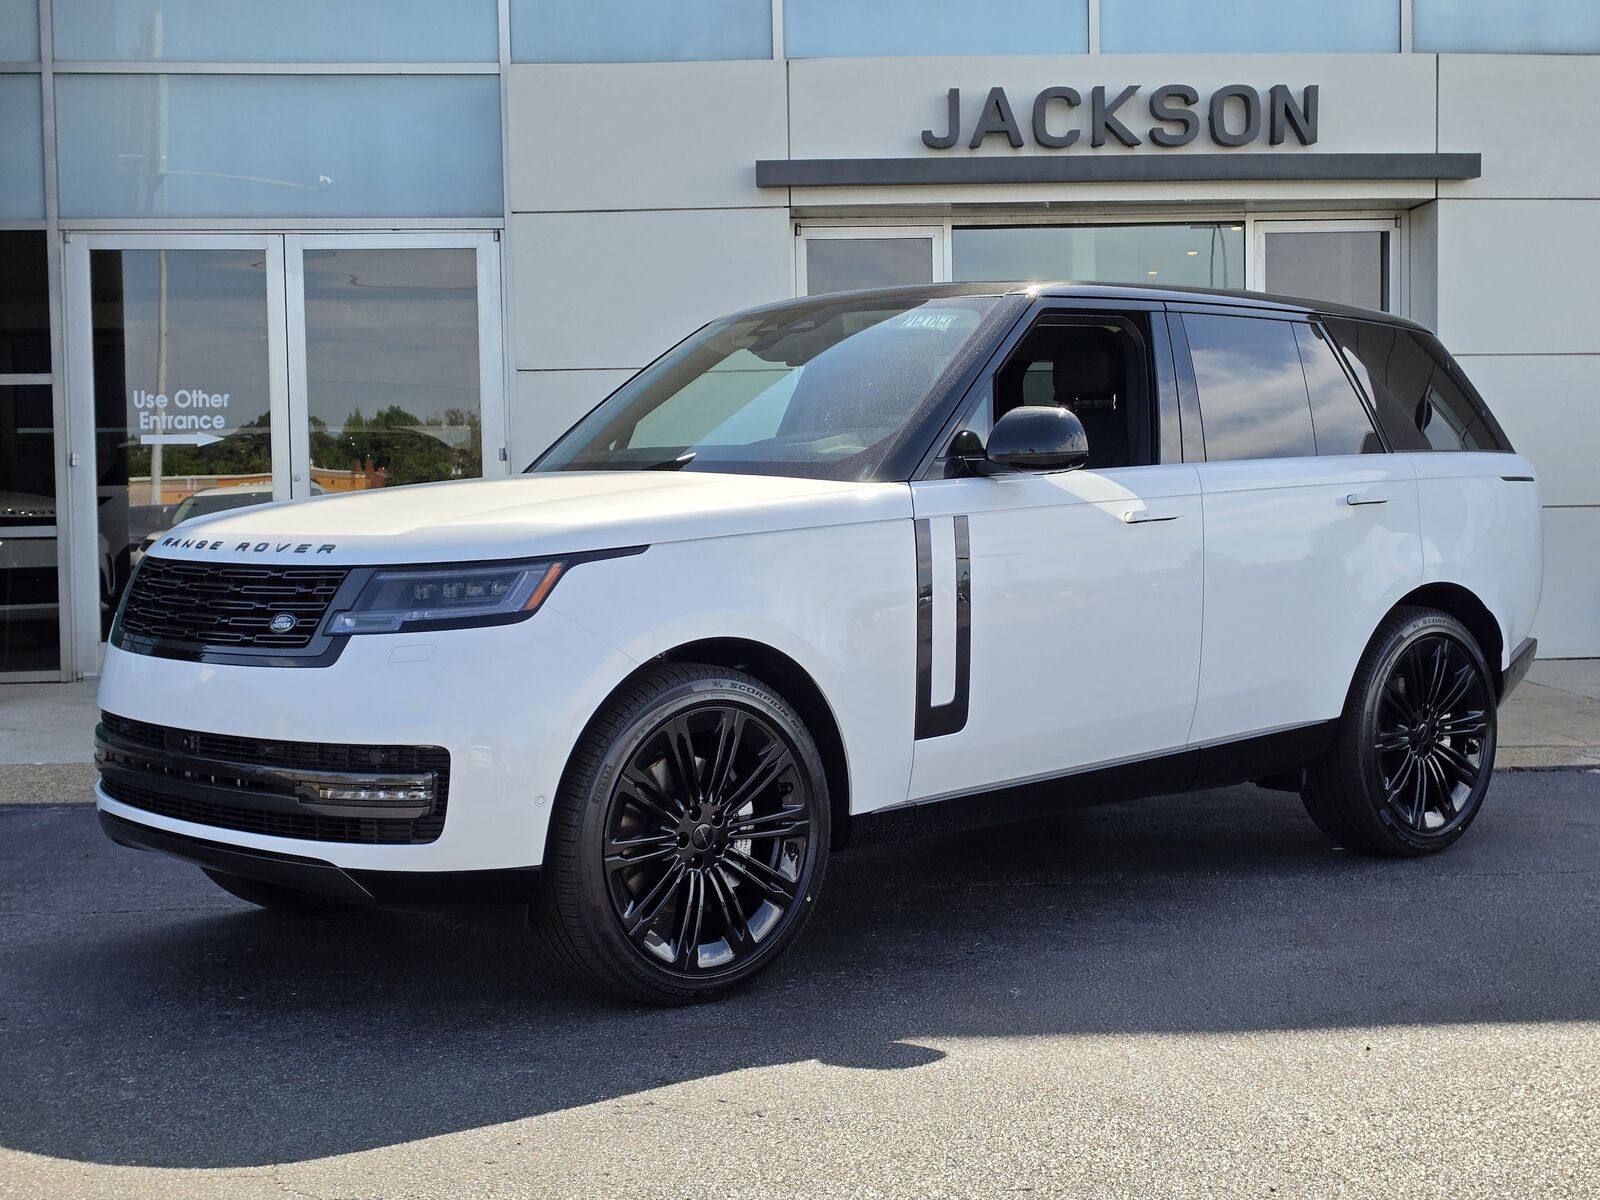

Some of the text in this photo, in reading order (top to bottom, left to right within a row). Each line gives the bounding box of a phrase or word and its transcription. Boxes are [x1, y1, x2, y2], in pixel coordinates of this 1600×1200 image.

[921, 84, 1320, 150] JACKSON
[133, 389, 230, 408] Use Other
[139, 411, 226, 430] Entrance
[162, 537, 337, 554] RANGE ROVER
[729, 682, 789, 718] SCORPION
